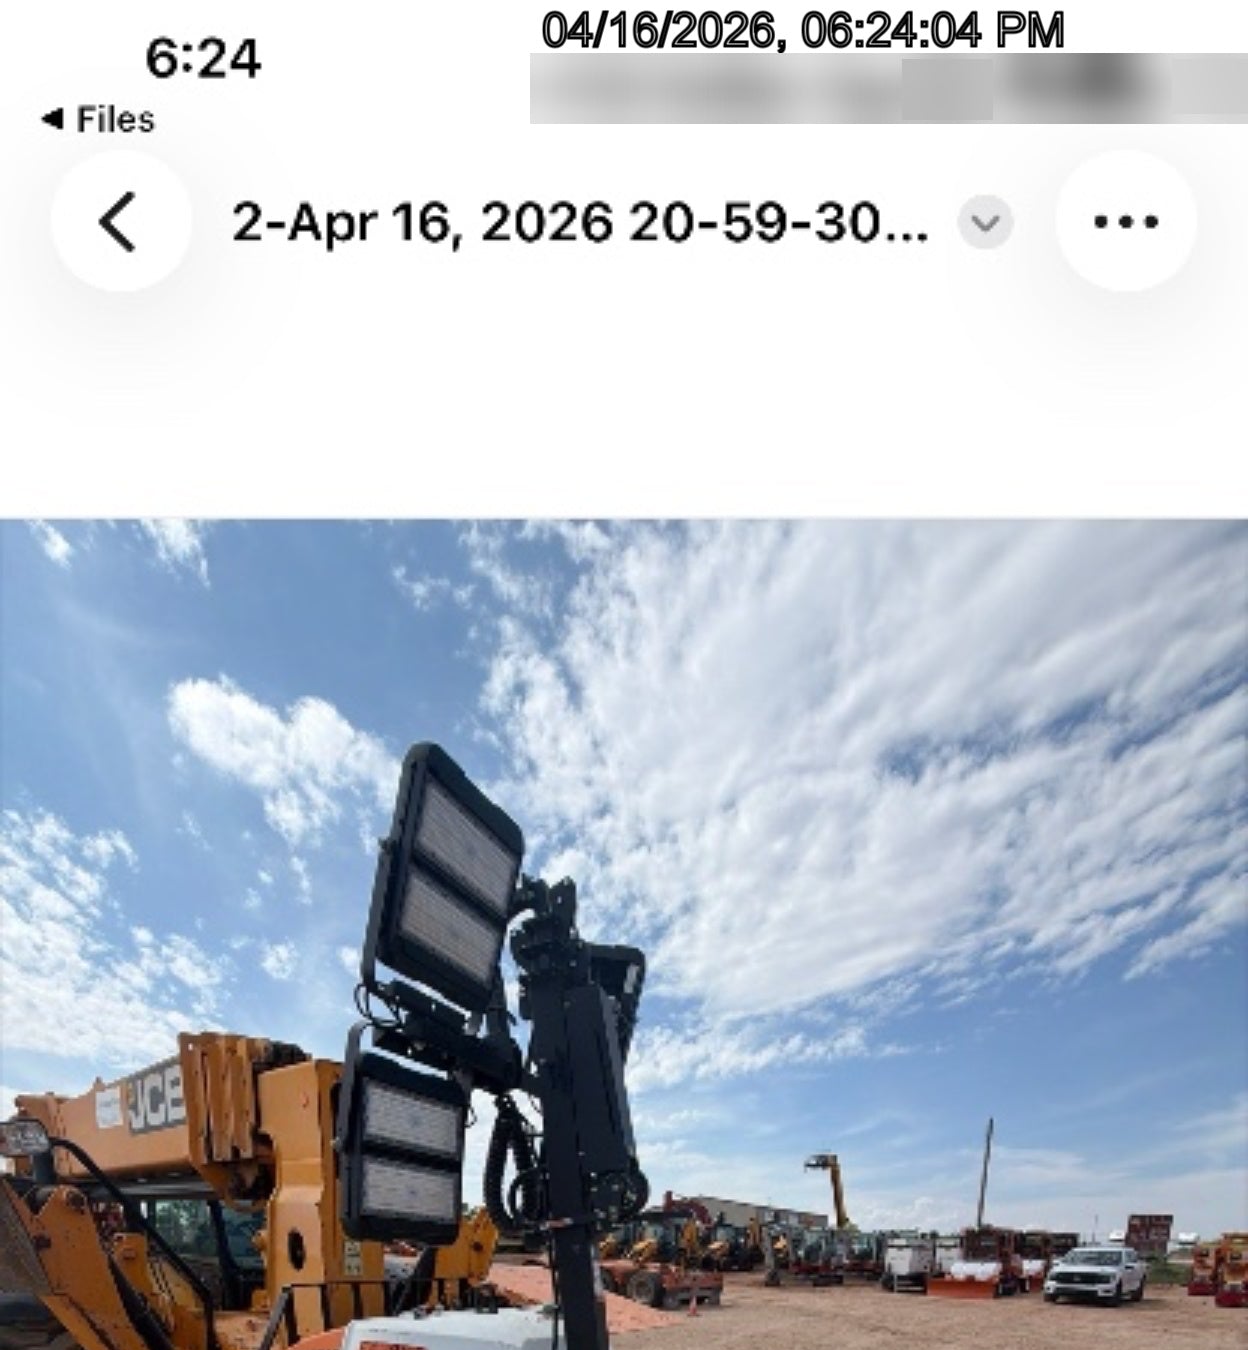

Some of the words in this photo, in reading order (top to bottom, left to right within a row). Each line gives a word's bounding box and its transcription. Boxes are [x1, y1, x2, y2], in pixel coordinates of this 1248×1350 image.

[146, 36, 262, 79] 6:24
[78, 104, 154, 133] Files
[233, 200, 379, 252] 2-Apr
[392, 201, 462, 253] 16,
[482, 200, 613, 244] 2026
